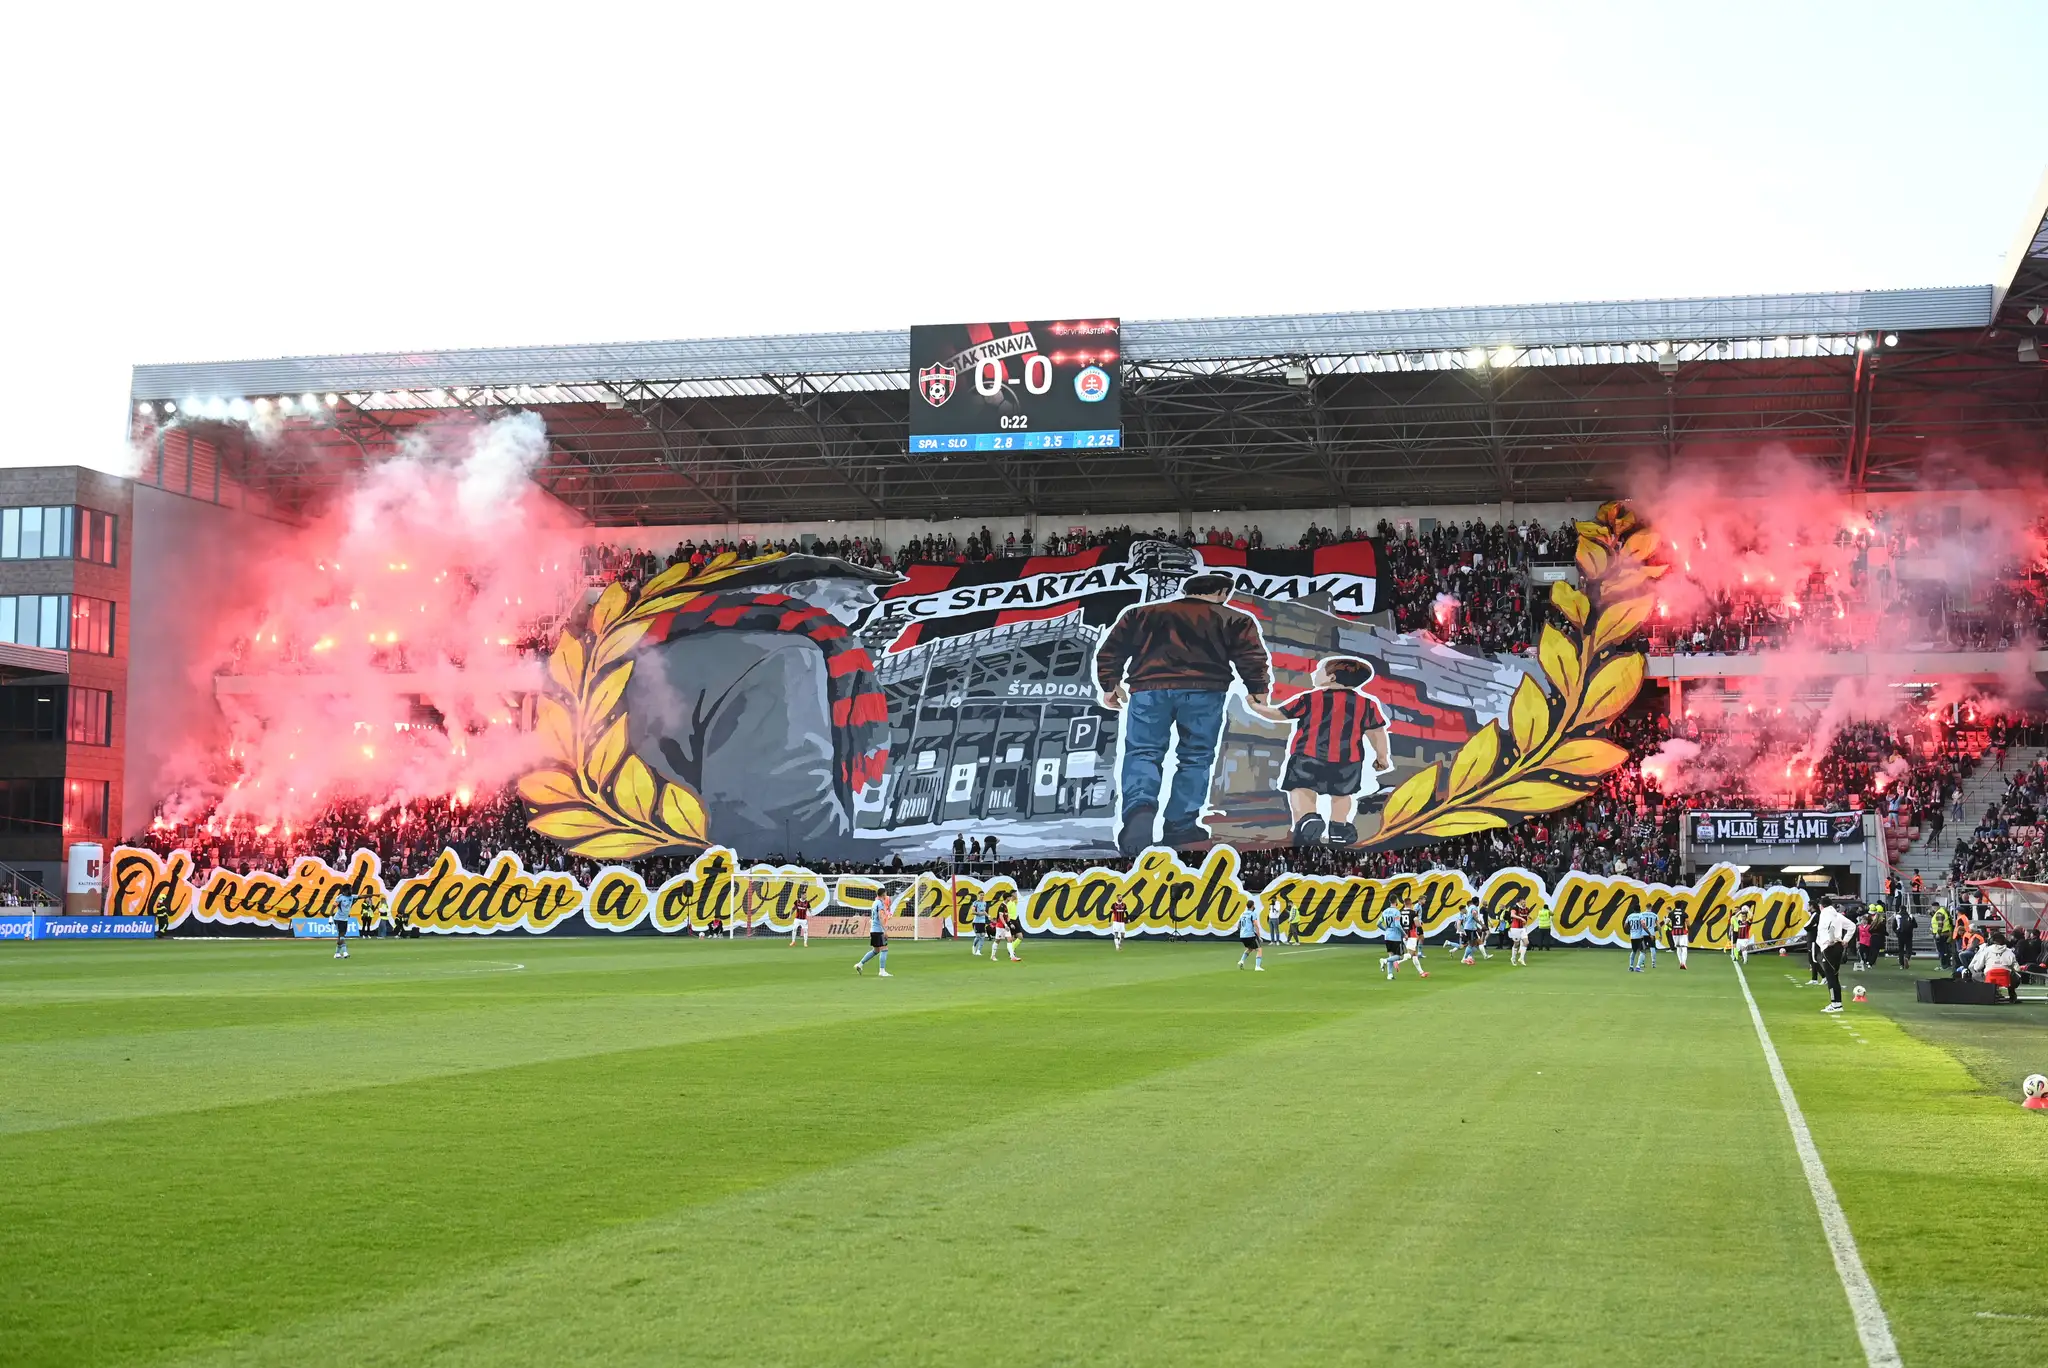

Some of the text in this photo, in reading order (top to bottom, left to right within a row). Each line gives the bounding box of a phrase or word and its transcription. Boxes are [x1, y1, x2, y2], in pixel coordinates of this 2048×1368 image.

[980, 334, 1034, 358] TRNAVA
[1000, 415, 1028, 429] 0:22
[918, 439, 938, 449] SPA
[947, 438, 968, 448] SLO
[993, 437, 1013, 449] 2.8
[1043, 435, 1063, 447] 3.5
[1086, 434, 1114, 447] 2.25
[884, 597, 939, 618] FC
[948, 562, 1142, 611] SPARTAK
[1007, 679, 1092, 698] ŠTADION
[1074, 723, 1092, 745] P
[113, 856, 187, 916] Od
[404, 858, 575, 921] dedov
[596, 878, 639, 918] a
[1033, 856, 1240, 922] našich
[1488, 881, 1537, 920] a
[308, 921, 357, 935] Tipsprt
[828, 918, 859, 935] niké
[1675, 914, 1682, 925] 3
[0, 920, 33, 938] sport
[46, 921, 153, 938] Tipnite si z mobilu
